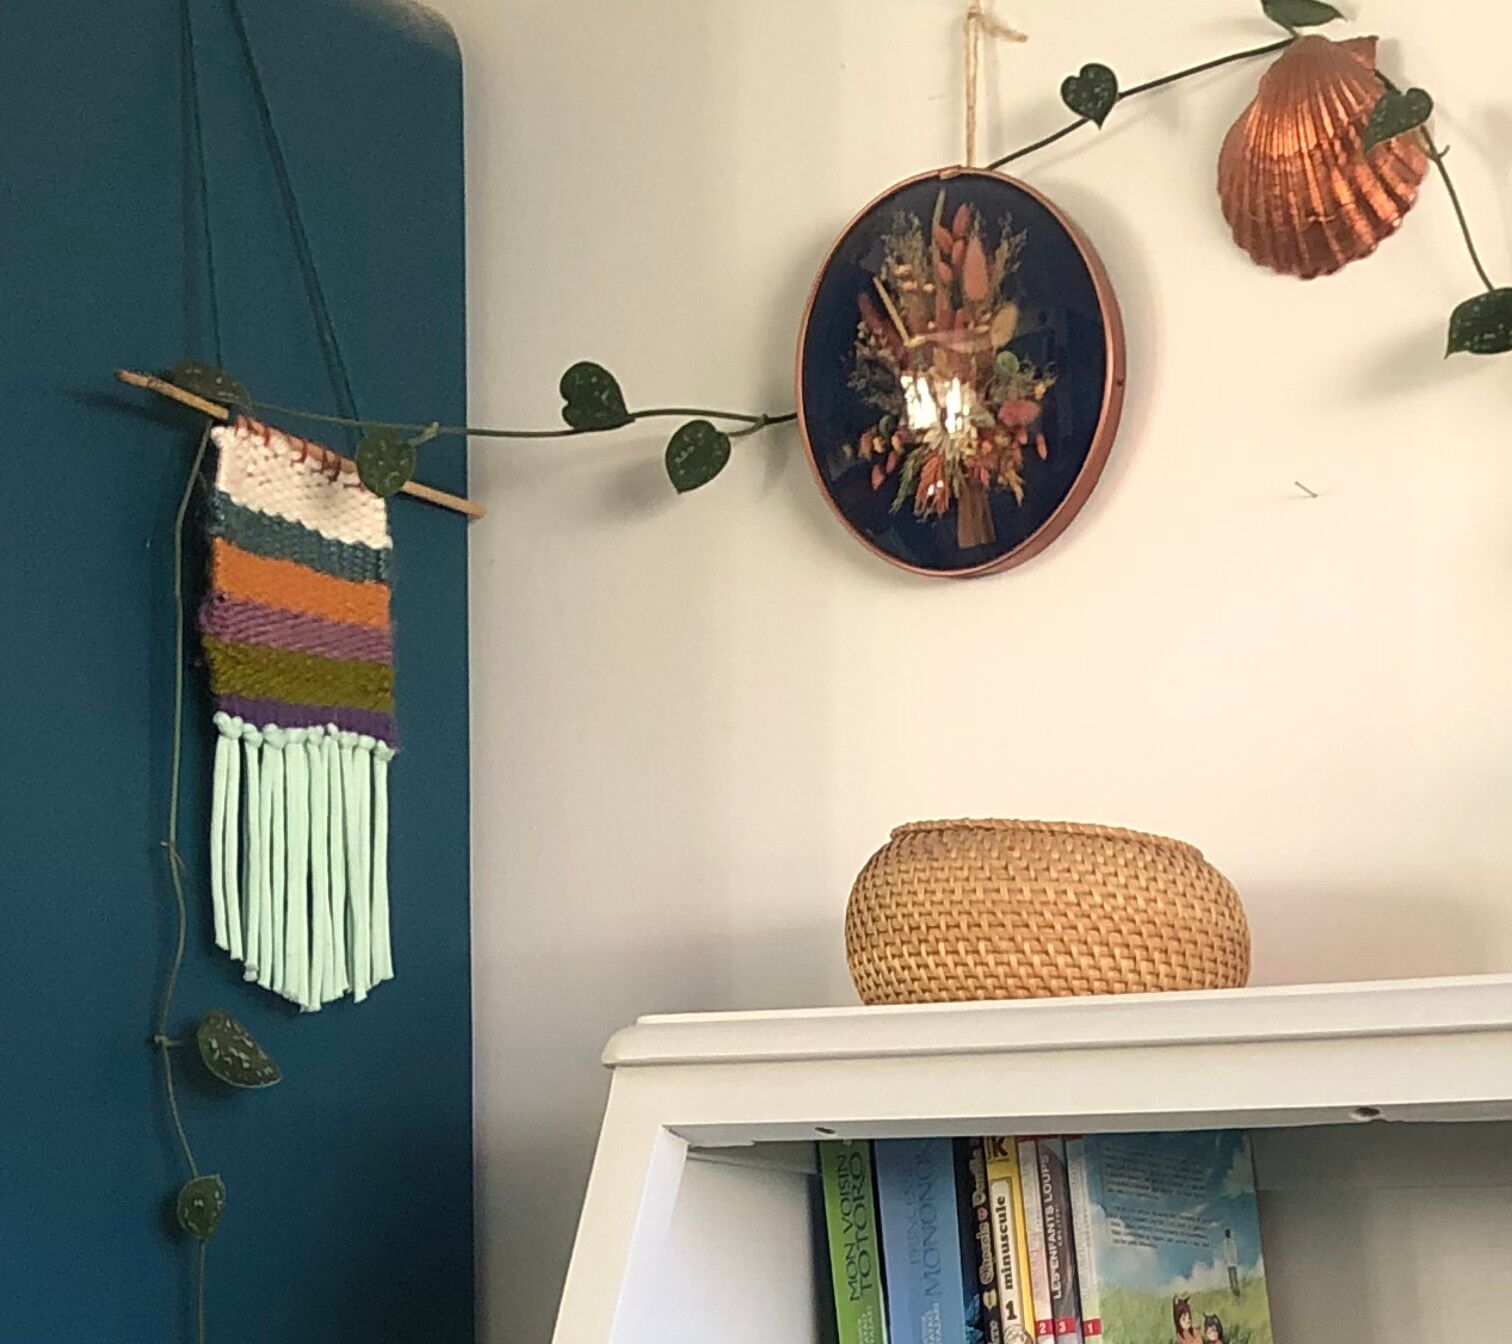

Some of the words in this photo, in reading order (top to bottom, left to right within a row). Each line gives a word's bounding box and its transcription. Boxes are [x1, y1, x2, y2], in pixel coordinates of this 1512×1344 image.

[836, 1154, 855, 1235] VOISIN
[1040, 1154, 1053, 1203] LOUPS
[849, 1152, 873, 1297] TOTORO
[995, 1195, 1014, 1290] minuscule
[1044, 1204, 1061, 1270] ENFANTS
[843, 1242, 861, 1301] MON
[1051, 1271, 1062, 1300] LES
[1005, 1300, 1017, 1320] 1
[1039, 1322, 1047, 1334] 2
[1059, 1321, 1067, 1334] 3
[1087, 1322, 1094, 1334] 1
